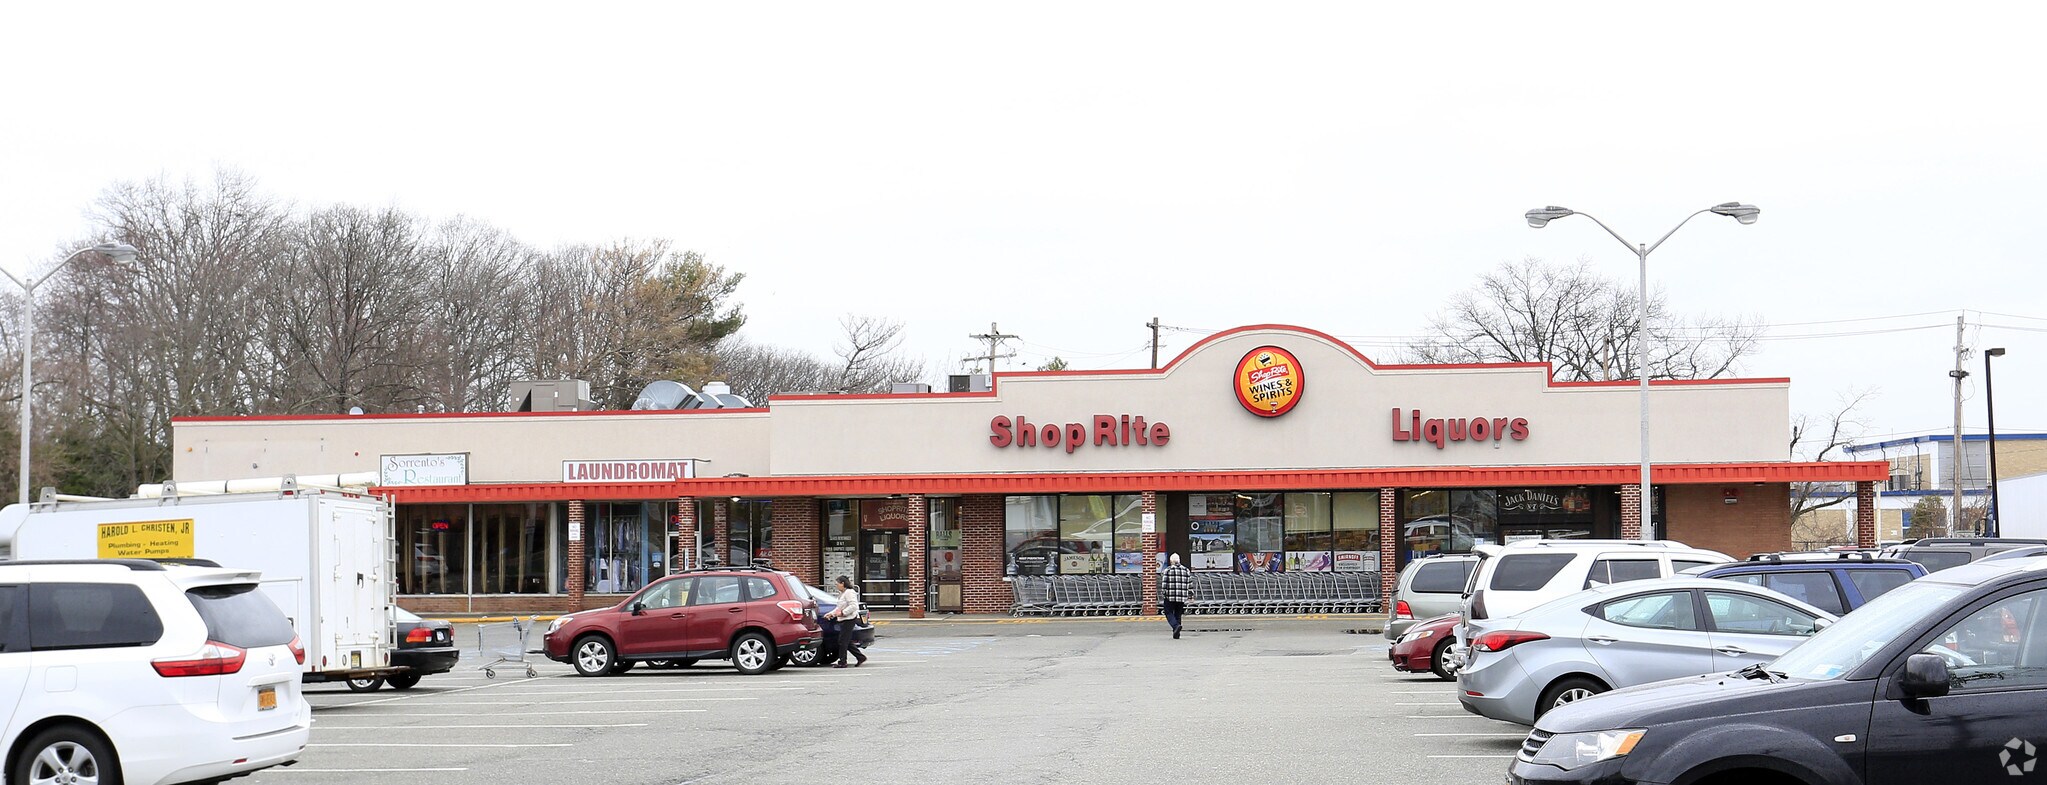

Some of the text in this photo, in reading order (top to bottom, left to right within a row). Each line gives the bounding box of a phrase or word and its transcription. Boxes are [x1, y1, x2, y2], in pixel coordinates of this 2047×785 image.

[1249, 378, 1292, 394] WINES &
[1253, 387, 1293, 403] SPIRITS
[1392, 408, 1529, 449] Liquors
[387, 456, 445, 472] Sorrento's
[568, 462, 688, 480] LAUNDROMAT
[404, 469, 462, 484] Restaurant
[1504, 494, 1525, 507] JACK
[102, 525, 128, 539] HAROLD
[181, 522, 190, 534] JR
